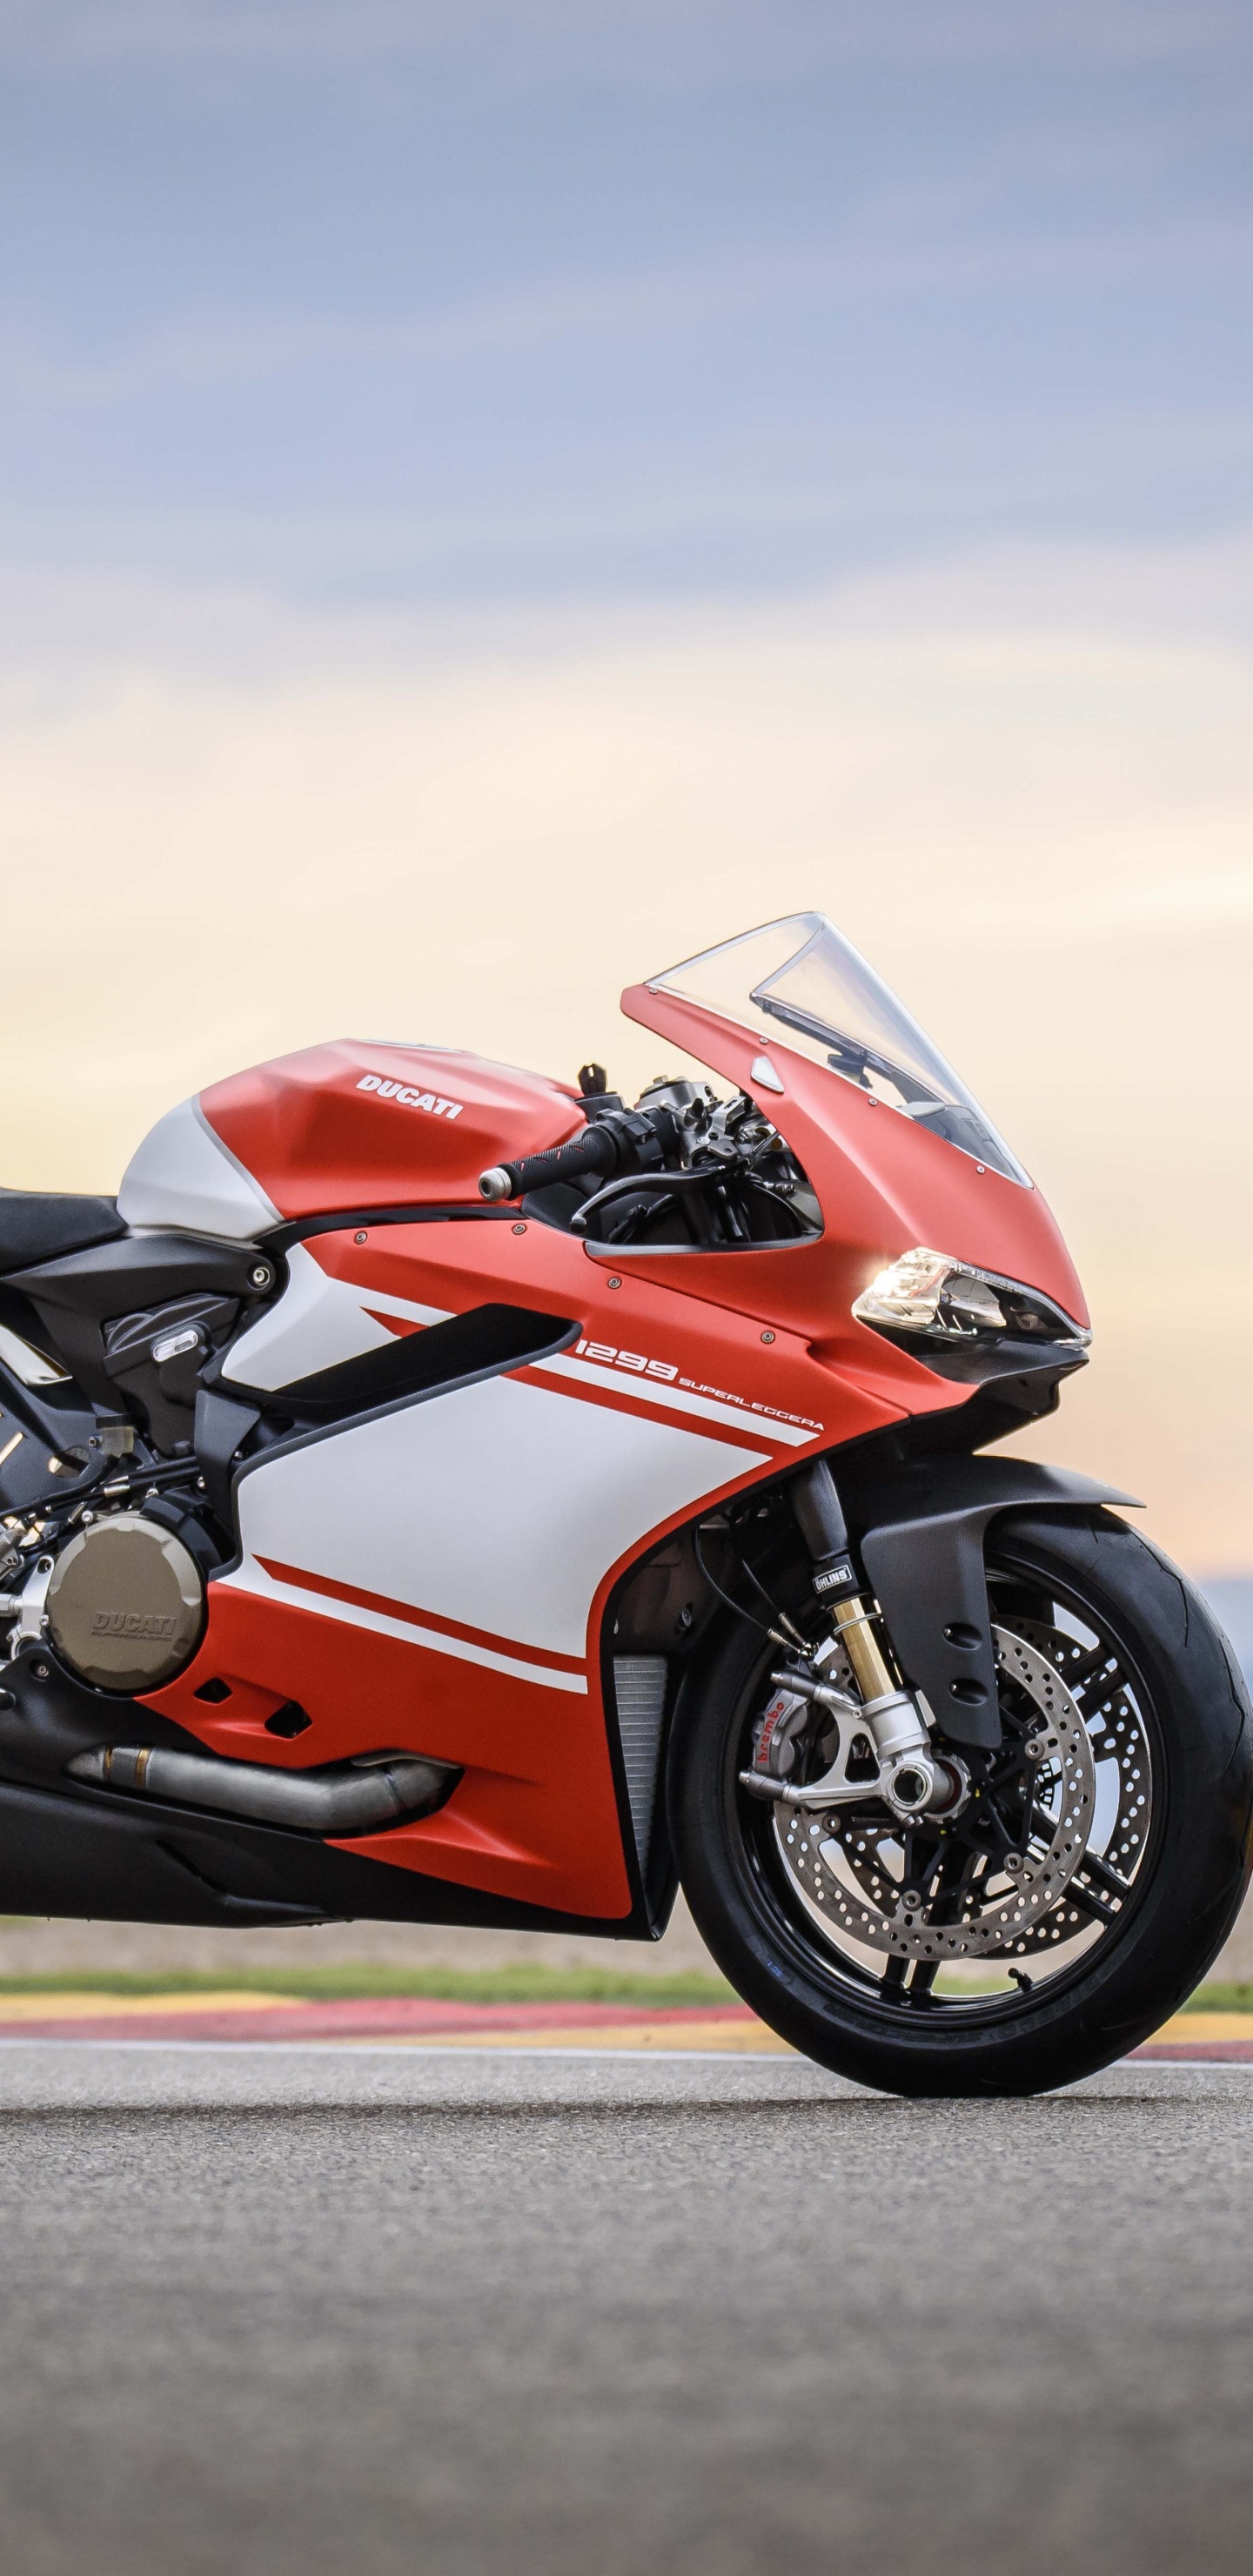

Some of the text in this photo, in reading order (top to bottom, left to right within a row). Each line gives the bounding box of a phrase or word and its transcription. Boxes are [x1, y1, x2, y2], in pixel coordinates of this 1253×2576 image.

[356, 1075, 463, 1119] DUCATI
[575, 1339, 824, 1431] 1299 SUPERLEGGERA
[93, 1612, 177, 1635] DUCATI
[757, 1702, 784, 1762] brembo
